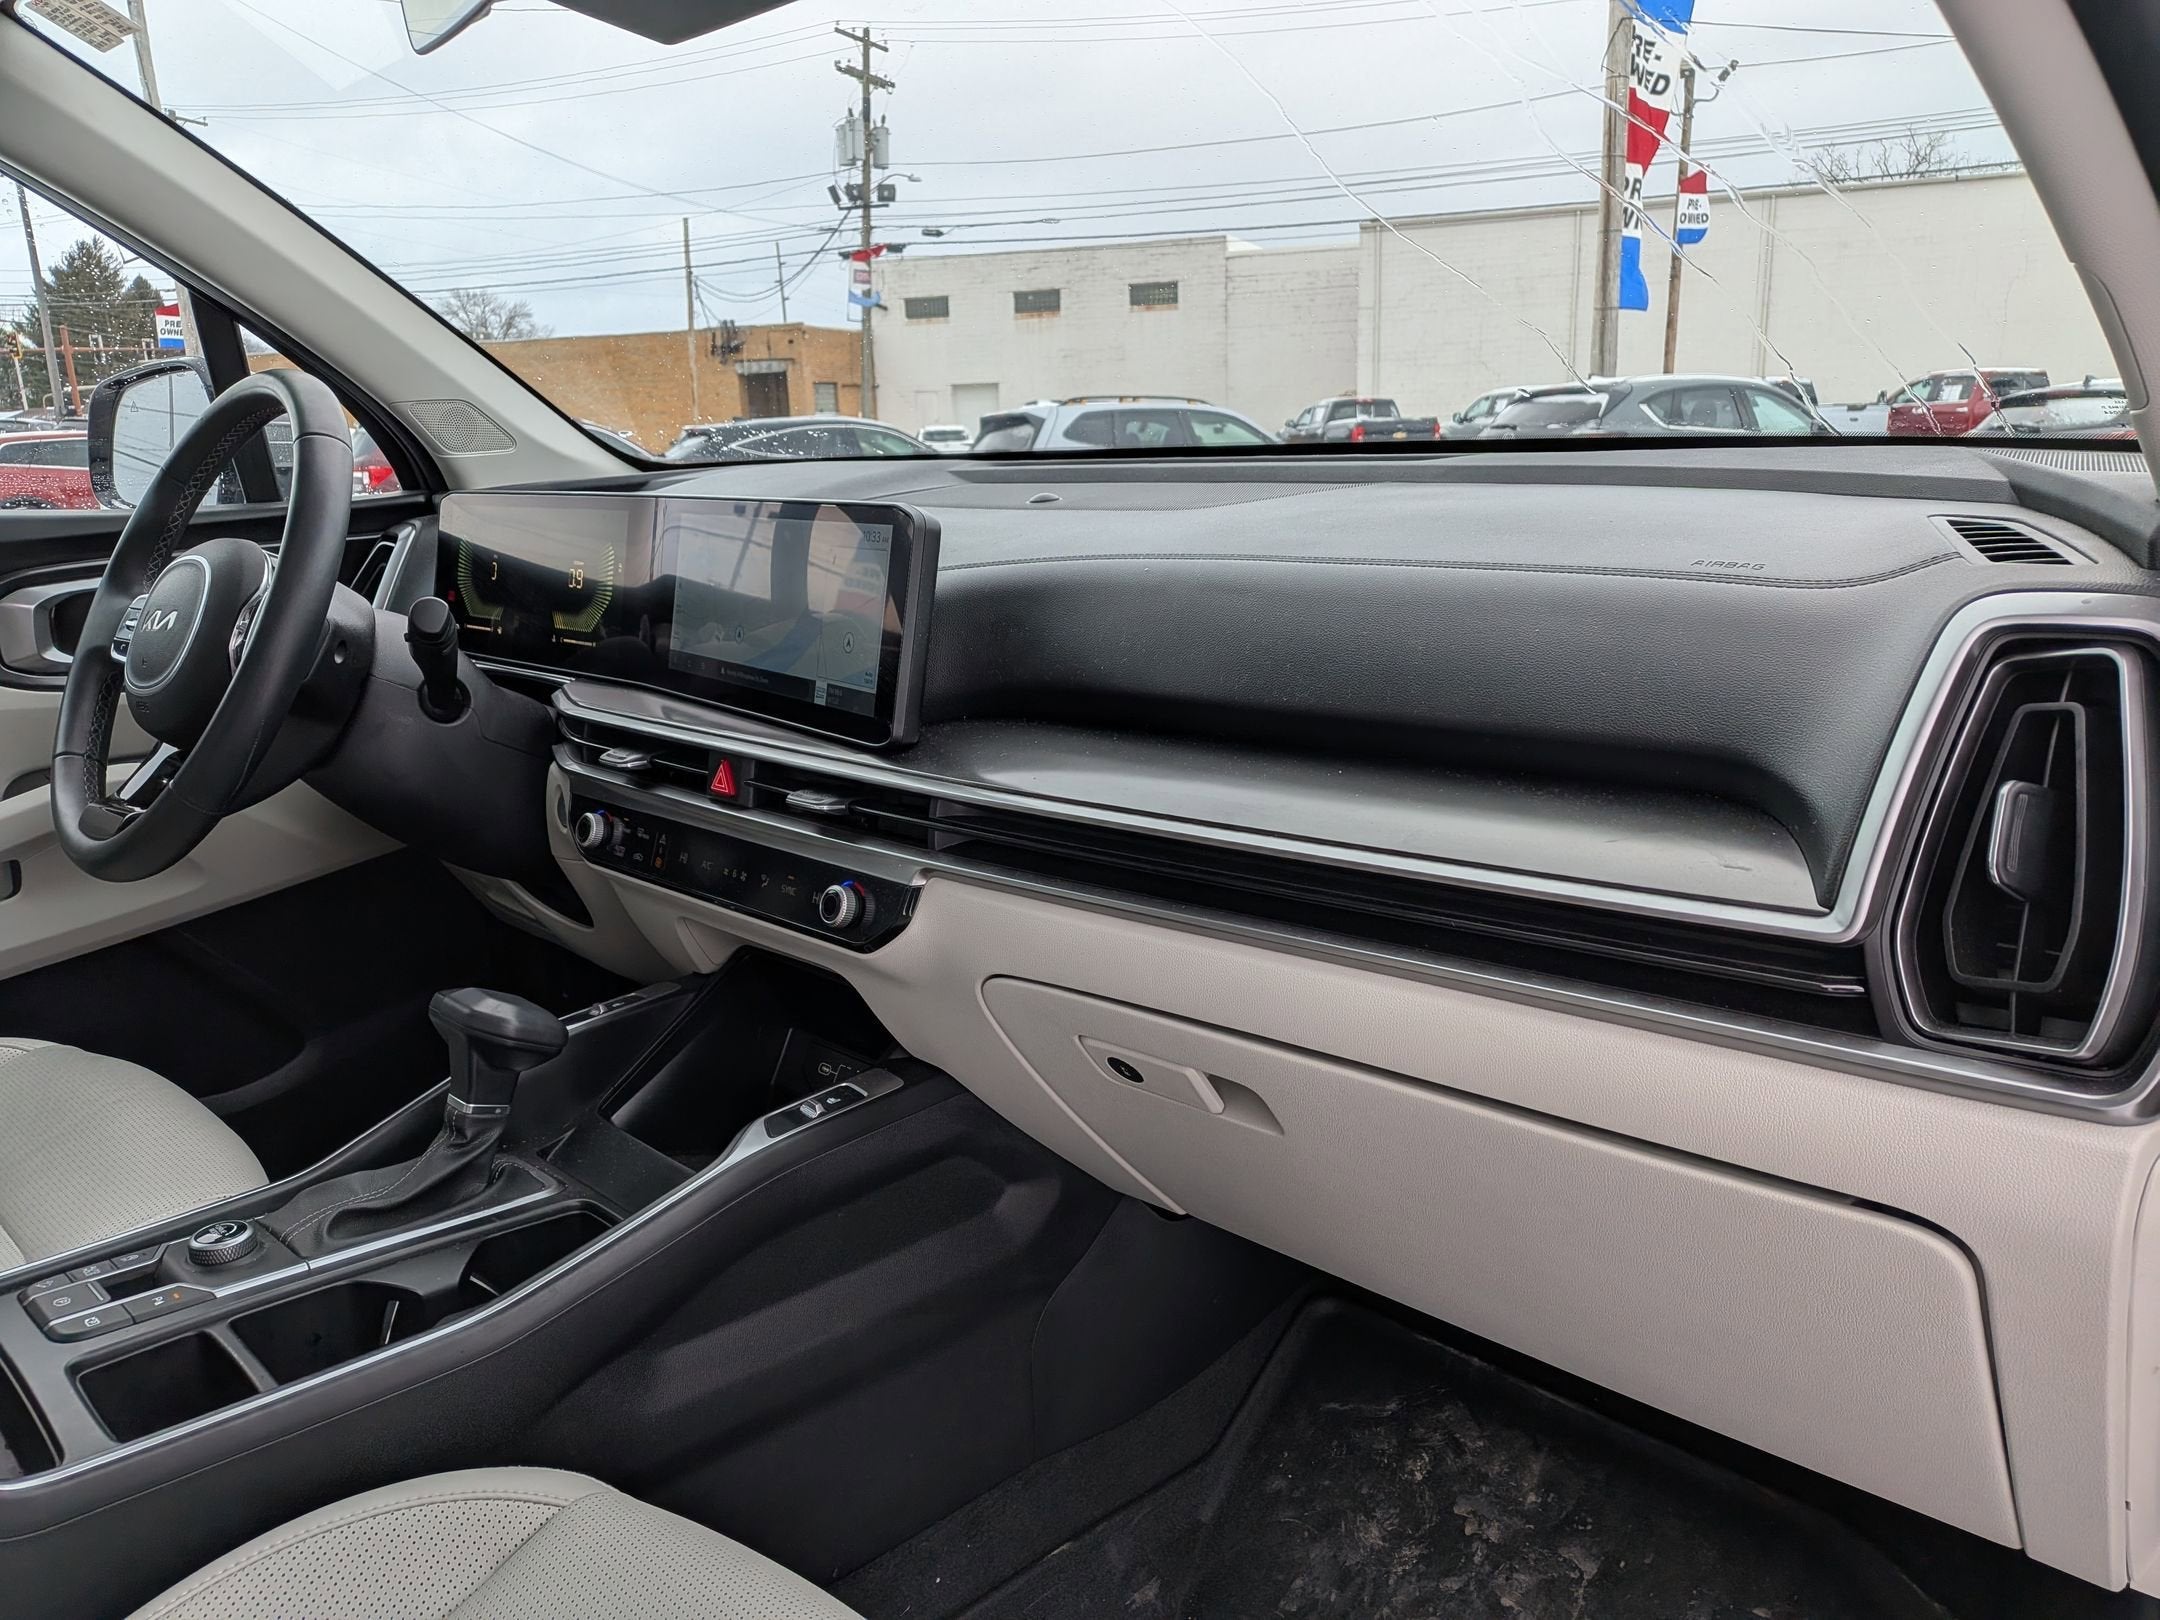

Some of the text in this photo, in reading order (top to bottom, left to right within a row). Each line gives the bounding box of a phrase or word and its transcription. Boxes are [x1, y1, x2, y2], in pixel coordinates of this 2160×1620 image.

[1631, 24, 1662, 64] RE-
[1690, 559, 1767, 572] AIRBAG
[142, 609, 178, 631] KIA
